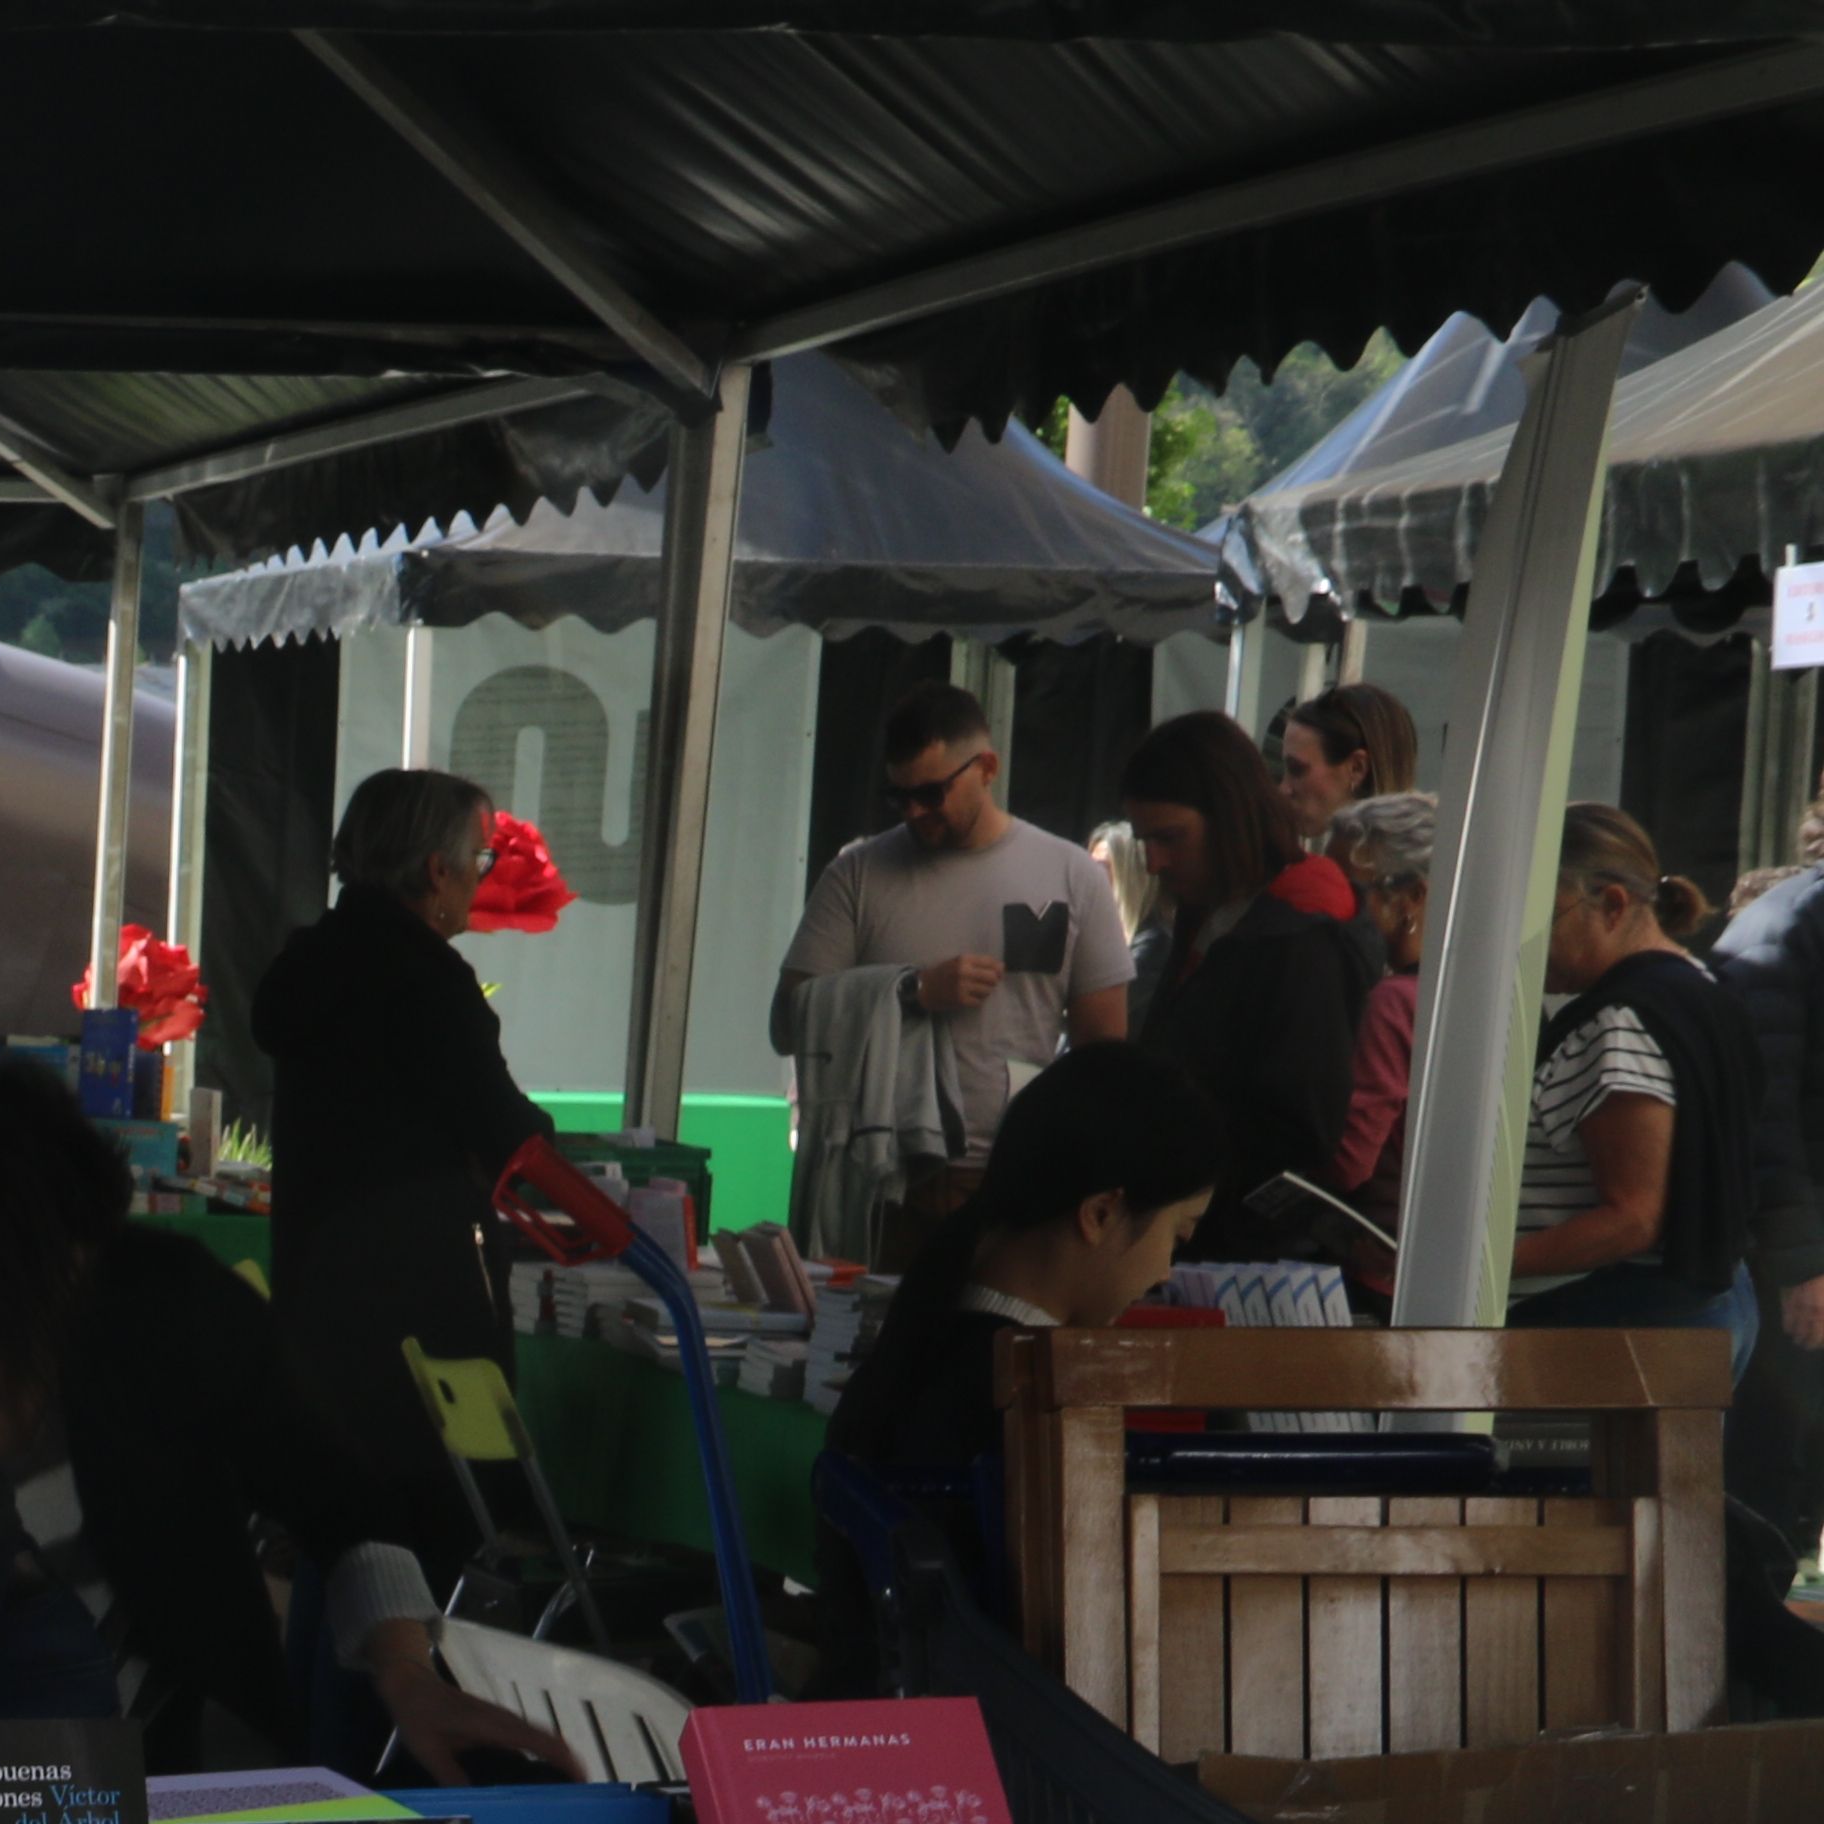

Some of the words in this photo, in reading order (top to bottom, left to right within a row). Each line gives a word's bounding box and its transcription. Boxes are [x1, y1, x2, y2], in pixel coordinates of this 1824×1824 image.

[743, 1738, 796, 1752] ERAN
[803, 1733, 912, 1749] HERMANAS
[48, 1783, 121, 1807] Víctor
